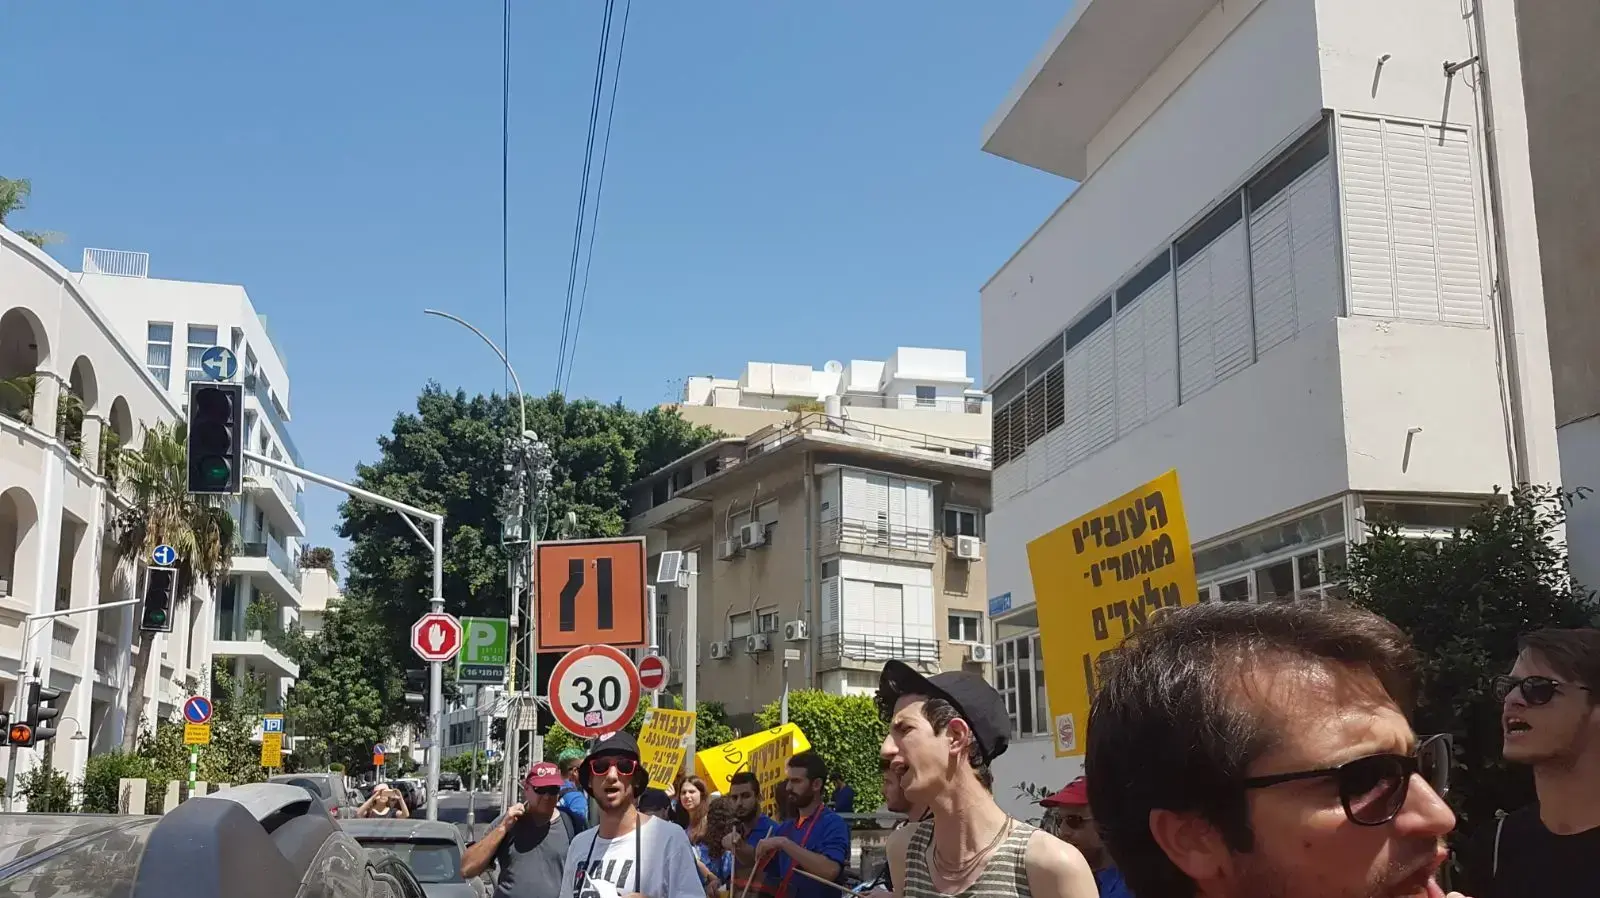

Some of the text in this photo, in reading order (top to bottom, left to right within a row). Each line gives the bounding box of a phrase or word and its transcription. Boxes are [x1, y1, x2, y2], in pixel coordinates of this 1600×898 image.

[467, 622, 497, 661] P
[478, 668, 503, 677] נחמני
[571, 676, 622, 712] 30
[648, 711, 692, 736] עבודה
